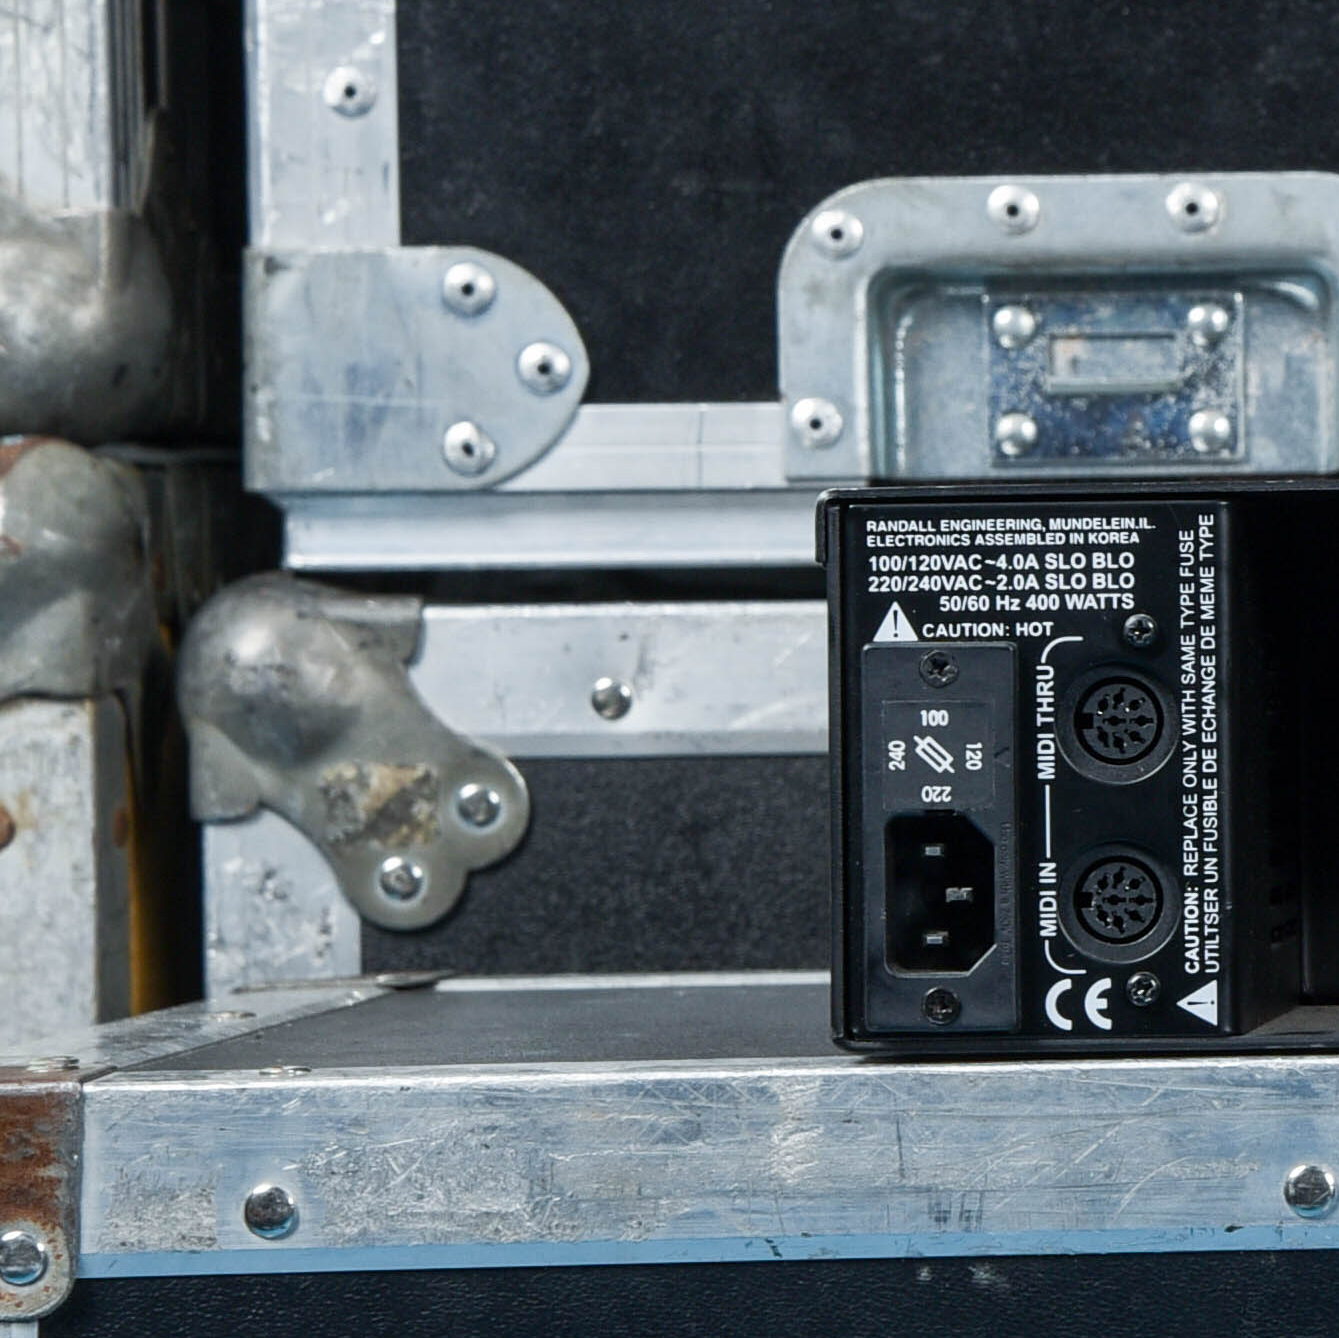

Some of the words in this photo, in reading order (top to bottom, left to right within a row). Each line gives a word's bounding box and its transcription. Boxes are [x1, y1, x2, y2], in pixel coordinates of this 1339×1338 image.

[867, 520, 936, 532] RANDALL
[940, 518, 1046, 532] ENGINEERING,
[867, 534, 970, 547] ELECTRONICS
[975, 533, 1066, 546] ASSEMBLED
[1070, 533, 1084, 544] IN
[1088, 532, 1139, 544] KOREA
[1199, 515, 1213, 561] TYPE
[1045, 553, 1086, 569] SLO
[1092, 552, 1134, 569] BLO
[1179, 530, 1194, 576] FUSE
[1045, 573, 1086, 590] SLO
[1093, 572, 1134, 589] BLO
[1200, 567, 1214, 619] MEME
[940, 595, 989, 611] 50/60
[996, 595, 1020, 610] Hz
[1025, 594, 1060, 610] 400
[1065, 593, 1134, 610] WATTS
[1180, 583, 1194, 629] TYPE
[923, 623, 1009, 637] CAUTION:
[1016, 622, 1054, 636] HOT
[1201, 625, 1215, 649] DE
[1181, 635, 1196, 684] SAME
[1036, 666, 1054, 726] THRU
[1181, 690, 1196, 735] WITH
[1201, 655, 1216, 742] ECHANGE
[920, 710, 949, 727] 100
[888, 740, 906, 770] 240
[965, 742, 982, 770] 120
[1037, 734, 1055, 779] MIDI
[1183, 741, 1197, 787] ONLY
[1202, 749, 1217, 772] DE
[921, 786, 952, 802] 220
[1203, 778, 1218, 852] FUSIBLE
[1183, 794, 1198, 876] REPLACE
[1039, 863, 1056, 883] IN
[1204, 858, 1218, 882] UN
[1039, 891, 1057, 936] MIDI
[1184, 887, 1199, 973] CAUTION:
